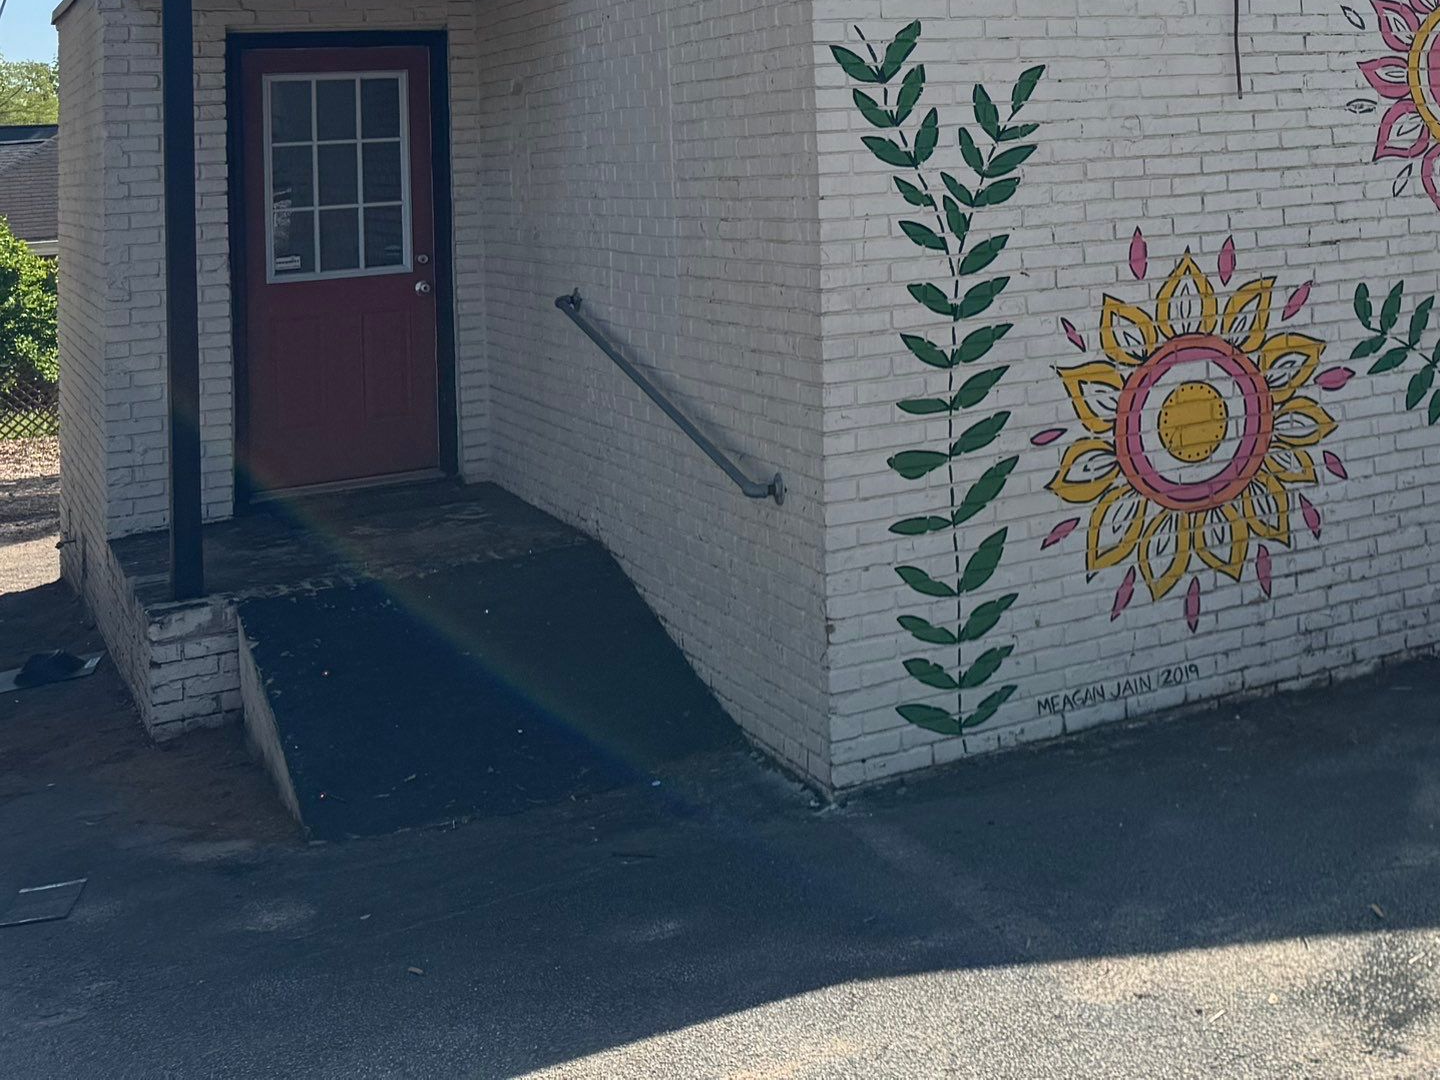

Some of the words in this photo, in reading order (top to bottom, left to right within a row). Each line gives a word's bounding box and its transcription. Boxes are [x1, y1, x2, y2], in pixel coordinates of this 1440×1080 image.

[1036, 684, 1106, 716] MEAGAN
[1110, 674, 1152, 699] JAIN
[1160, 663, 1200, 685] 2019
